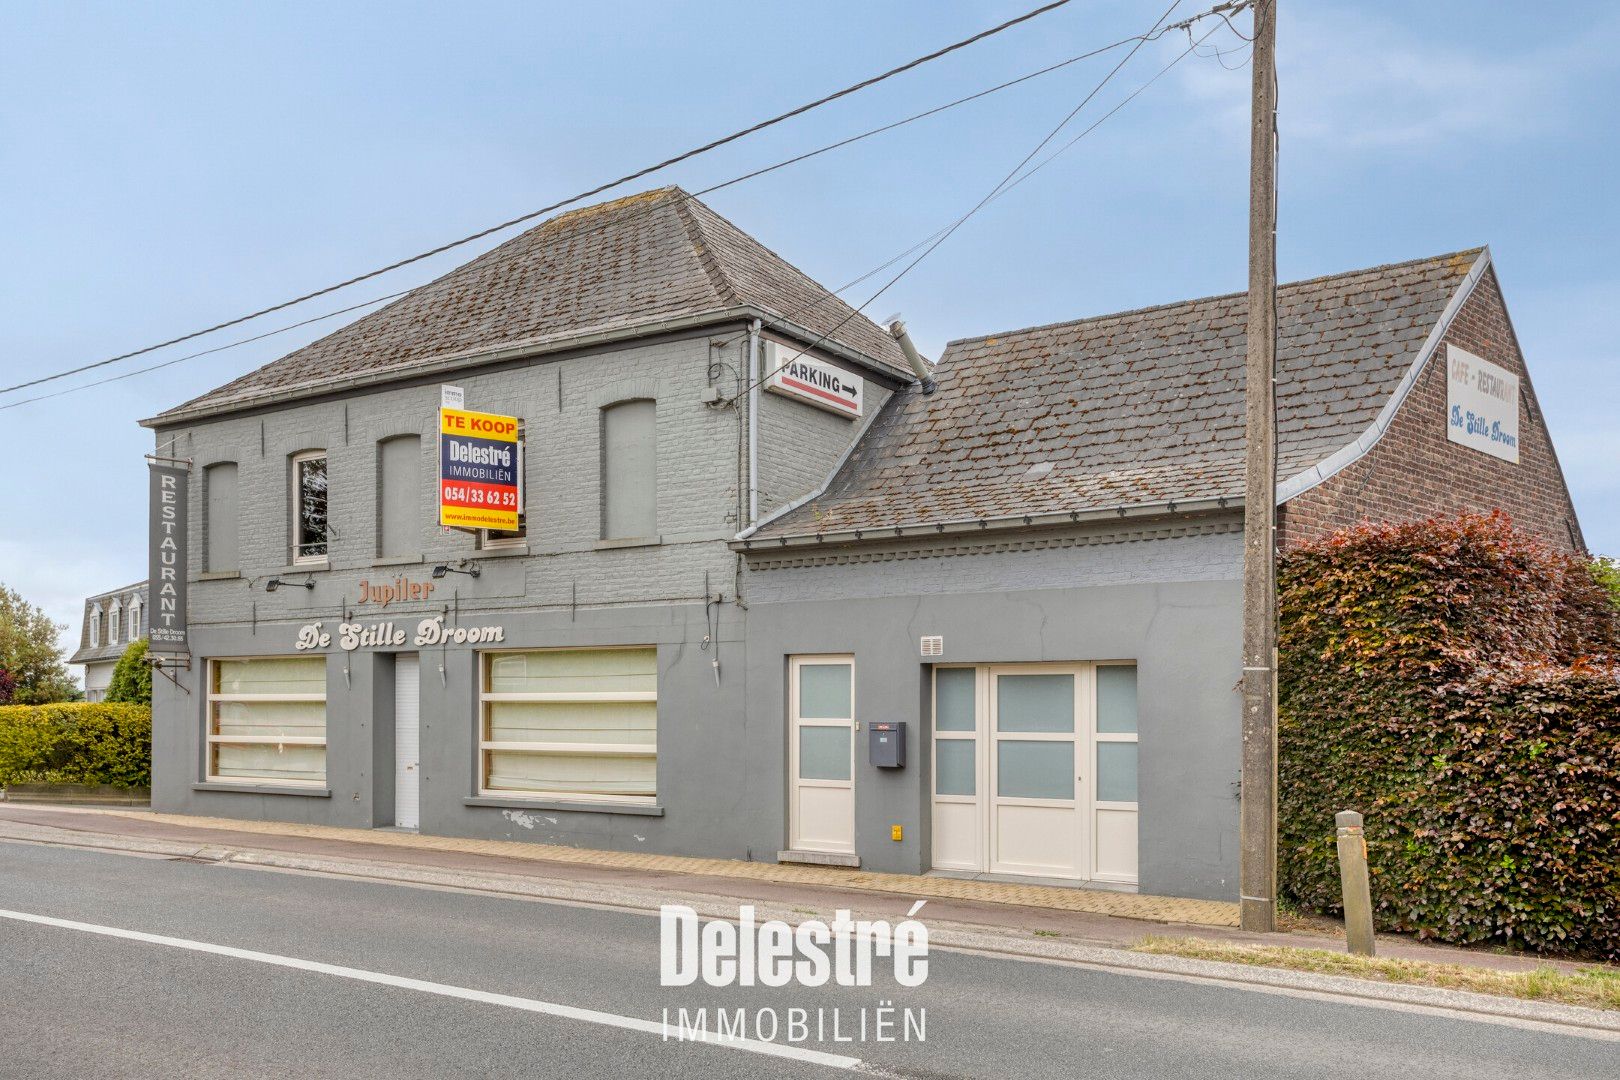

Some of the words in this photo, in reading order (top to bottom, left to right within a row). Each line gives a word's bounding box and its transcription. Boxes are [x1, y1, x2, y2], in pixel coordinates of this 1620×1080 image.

[781, 357, 840, 393] PARKING
[444, 414, 466, 429] TE
[471, 418, 515, 435] KOOP
[1450, 405, 1464, 428] De
[1466, 410, 1489, 435] Stille
[1491, 420, 1516, 448] Droom
[449, 440, 511, 468] Delestré
[449, 465, 511, 482] IMMOBILIËN
[444, 486, 484, 503] 054/33
[487, 490, 500, 505] 62
[503, 492, 516, 506] 52
[445, 512, 515, 525] www.immodelestre.be
[160, 474, 177, 627] RESTAURANT
[358, 578, 434, 607] Jupiler
[296, 622, 331, 649] De
[338, 621, 406, 651] Stille
[414, 616, 504, 646] Droom
